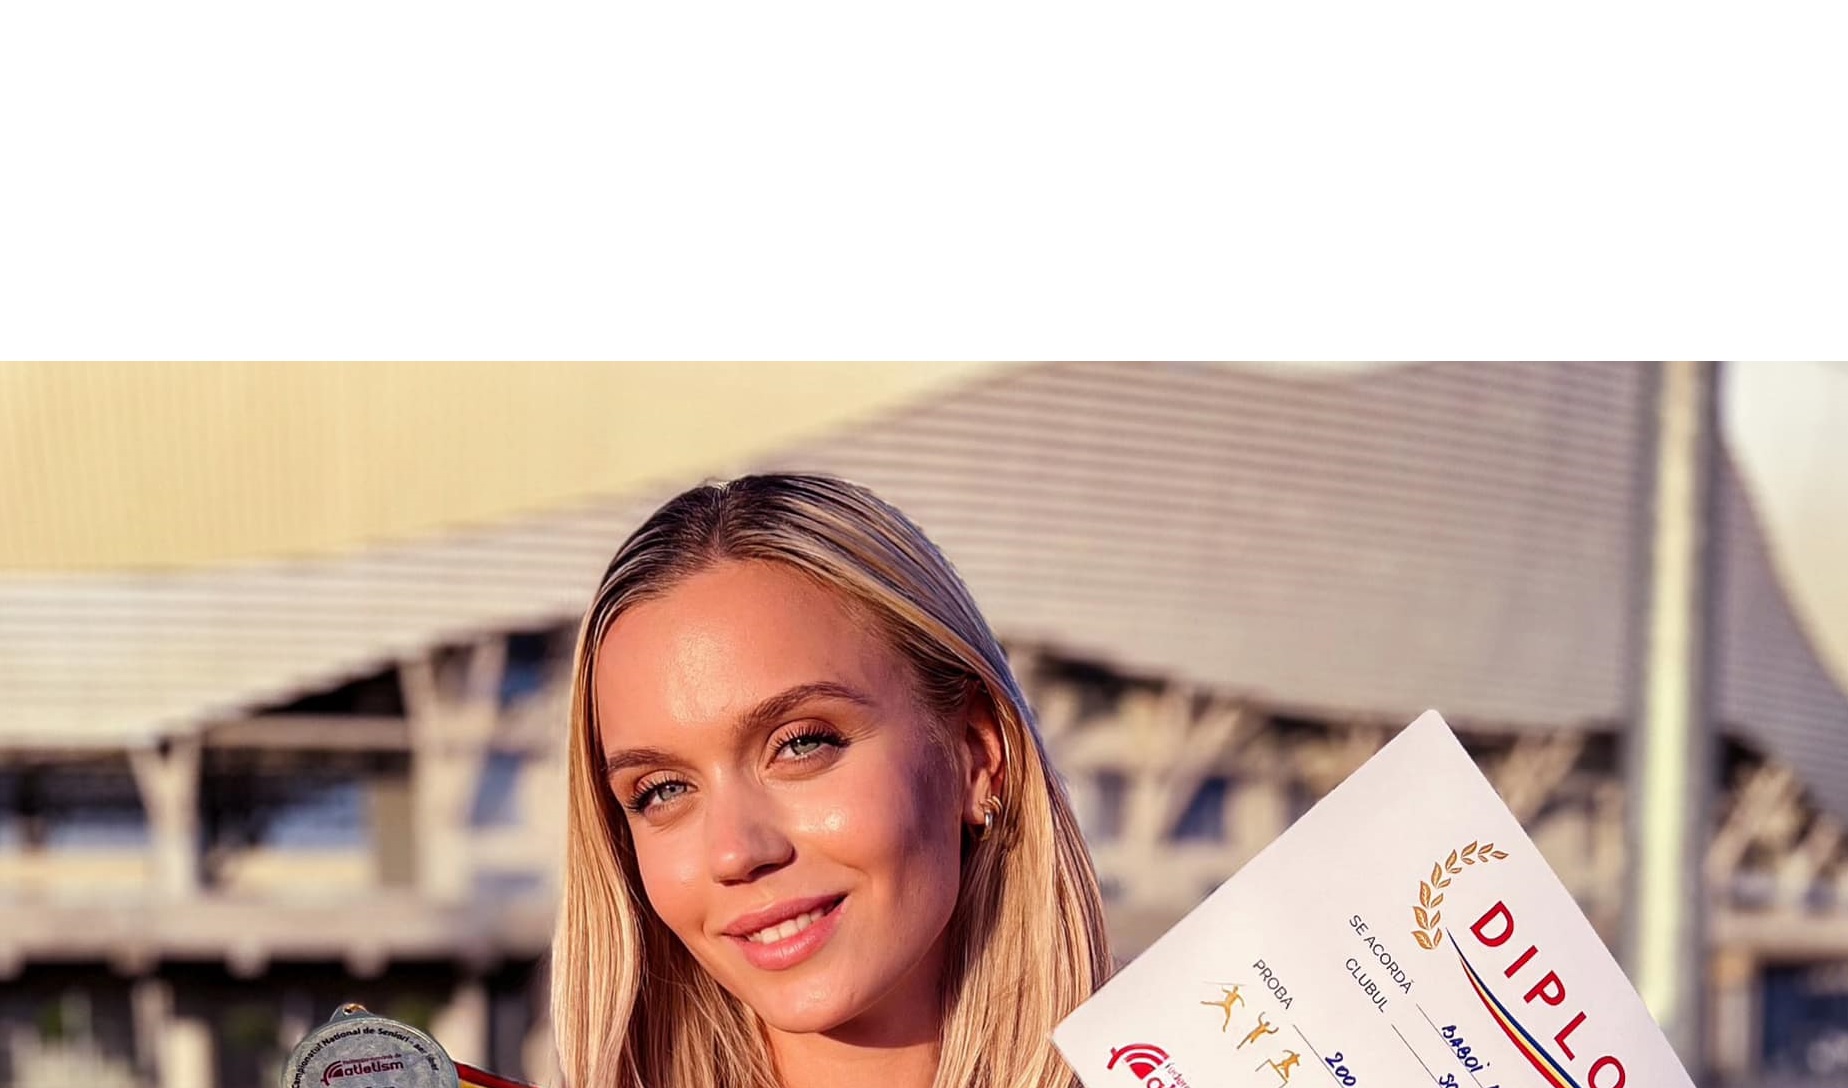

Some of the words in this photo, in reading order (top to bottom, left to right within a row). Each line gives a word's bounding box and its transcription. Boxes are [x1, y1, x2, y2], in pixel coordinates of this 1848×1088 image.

[1348, 915, 1369, 937] SE
[1252, 959, 1294, 1011] PROBA
[1345, 958, 1388, 1014] CLUBUL
[344, 1060, 404, 1076] atletism
